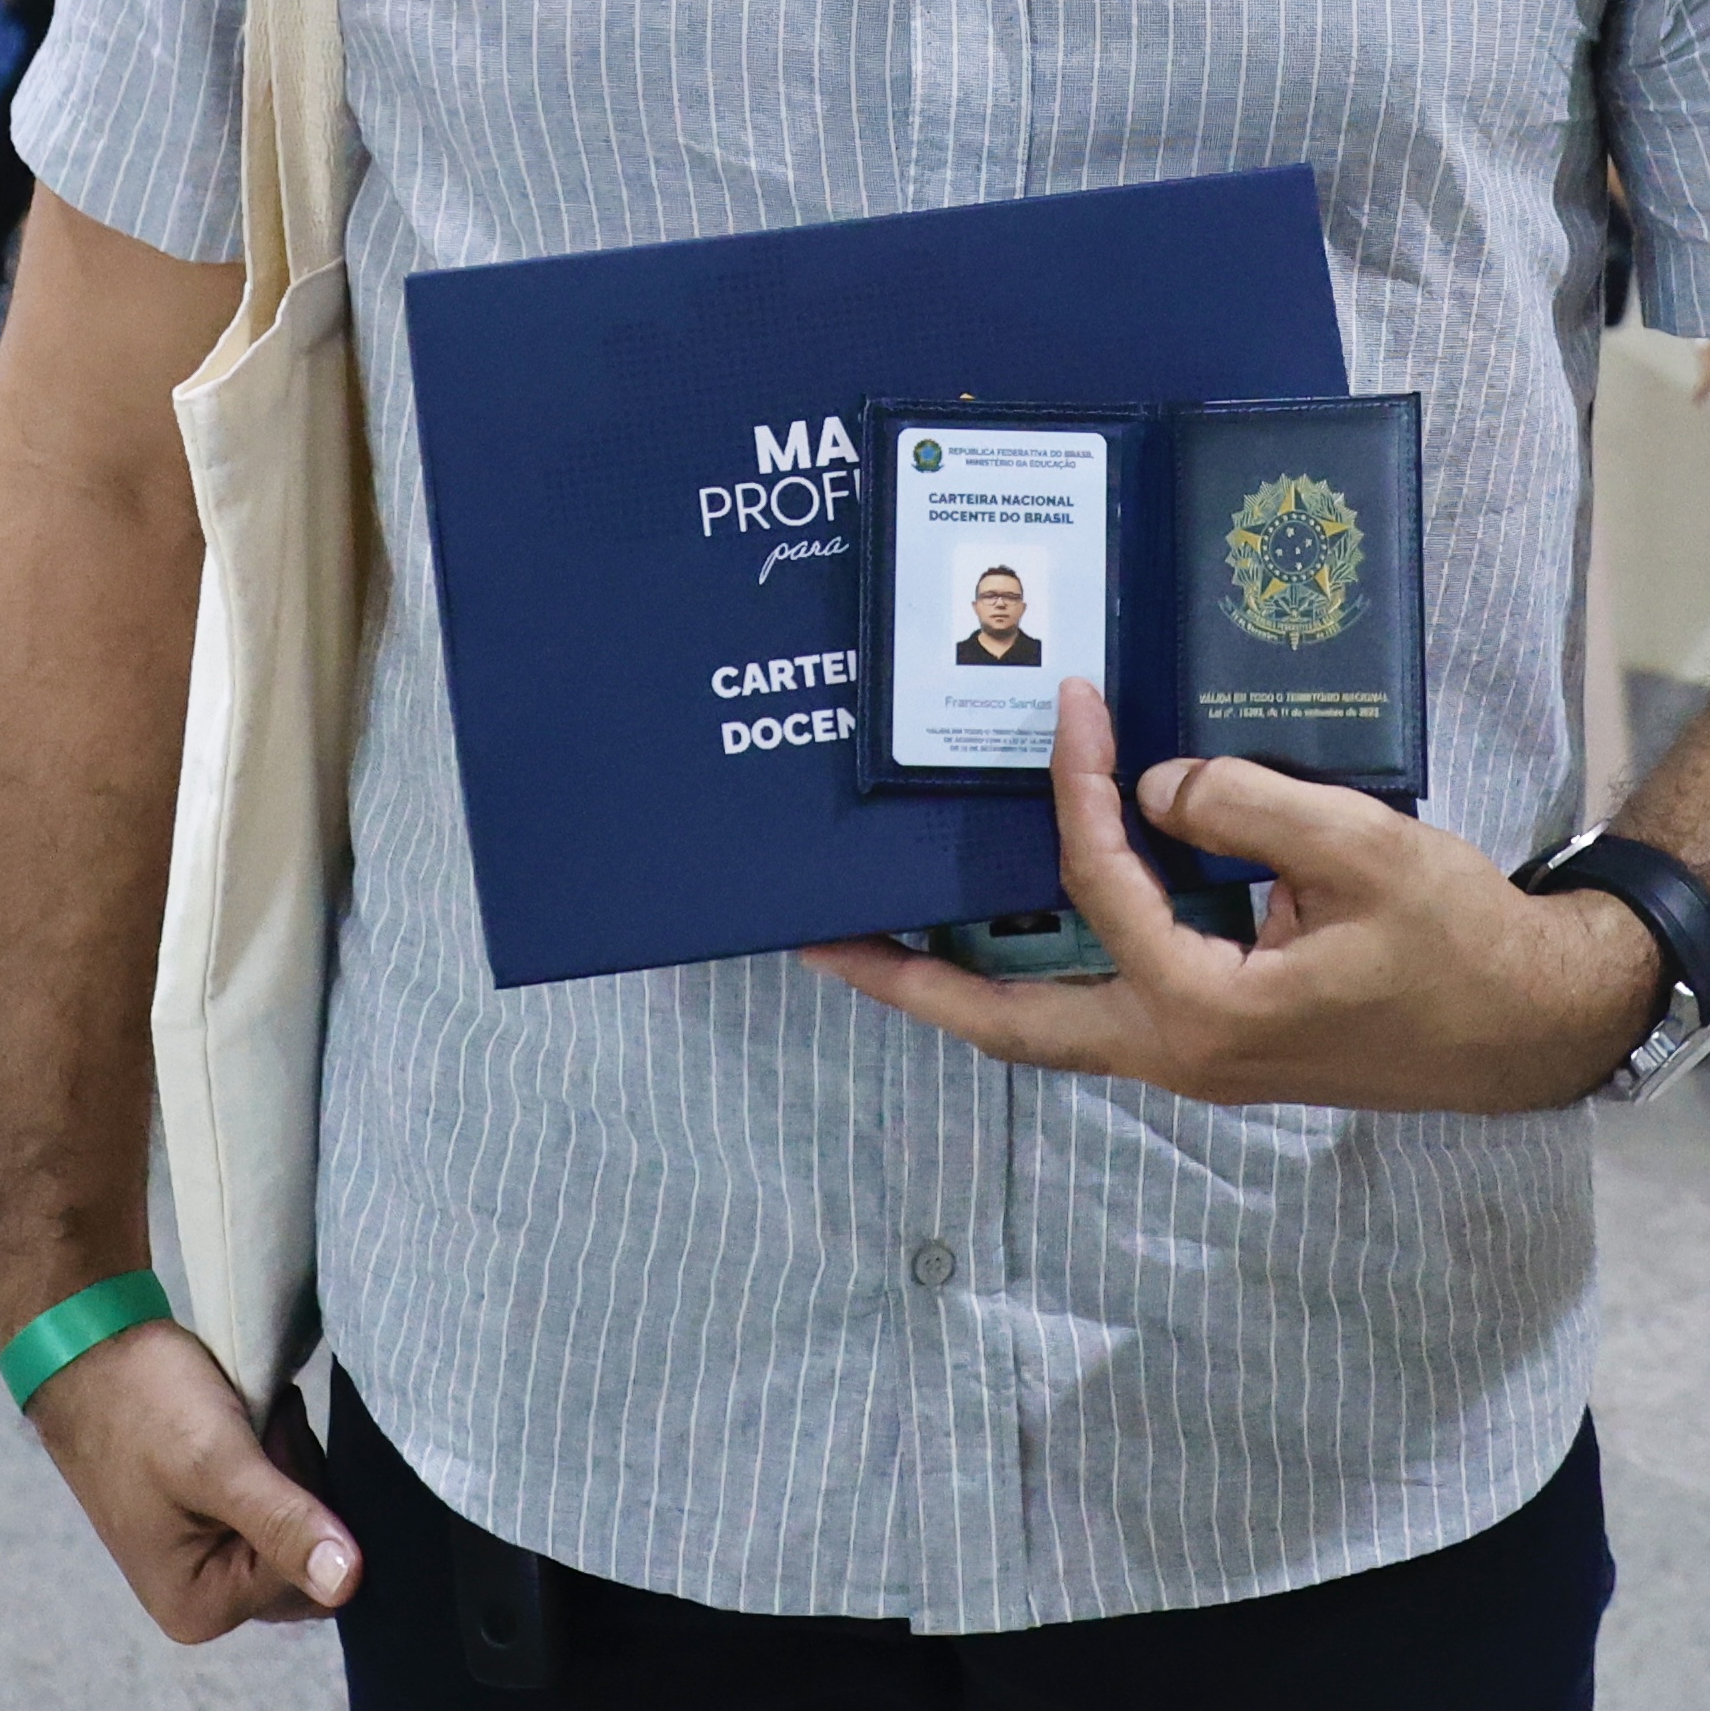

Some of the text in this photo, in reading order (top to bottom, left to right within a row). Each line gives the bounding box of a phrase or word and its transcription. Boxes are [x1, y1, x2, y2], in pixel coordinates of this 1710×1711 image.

[997, 448, 1048, 457] FEDERATIVA
[1050, 450, 1062, 458] DO
[966, 458, 1014, 467] MINISTÉRIO
[1029, 459, 1077, 470] EDUCAÇÃO
[929, 493, 1074, 507] CARTEIRA NACIONAL
[929, 510, 1074, 524] DOCENTE DO BRASIL
[758, 536, 850, 586] para
[945, 696, 1052, 710] Francisco Santos
